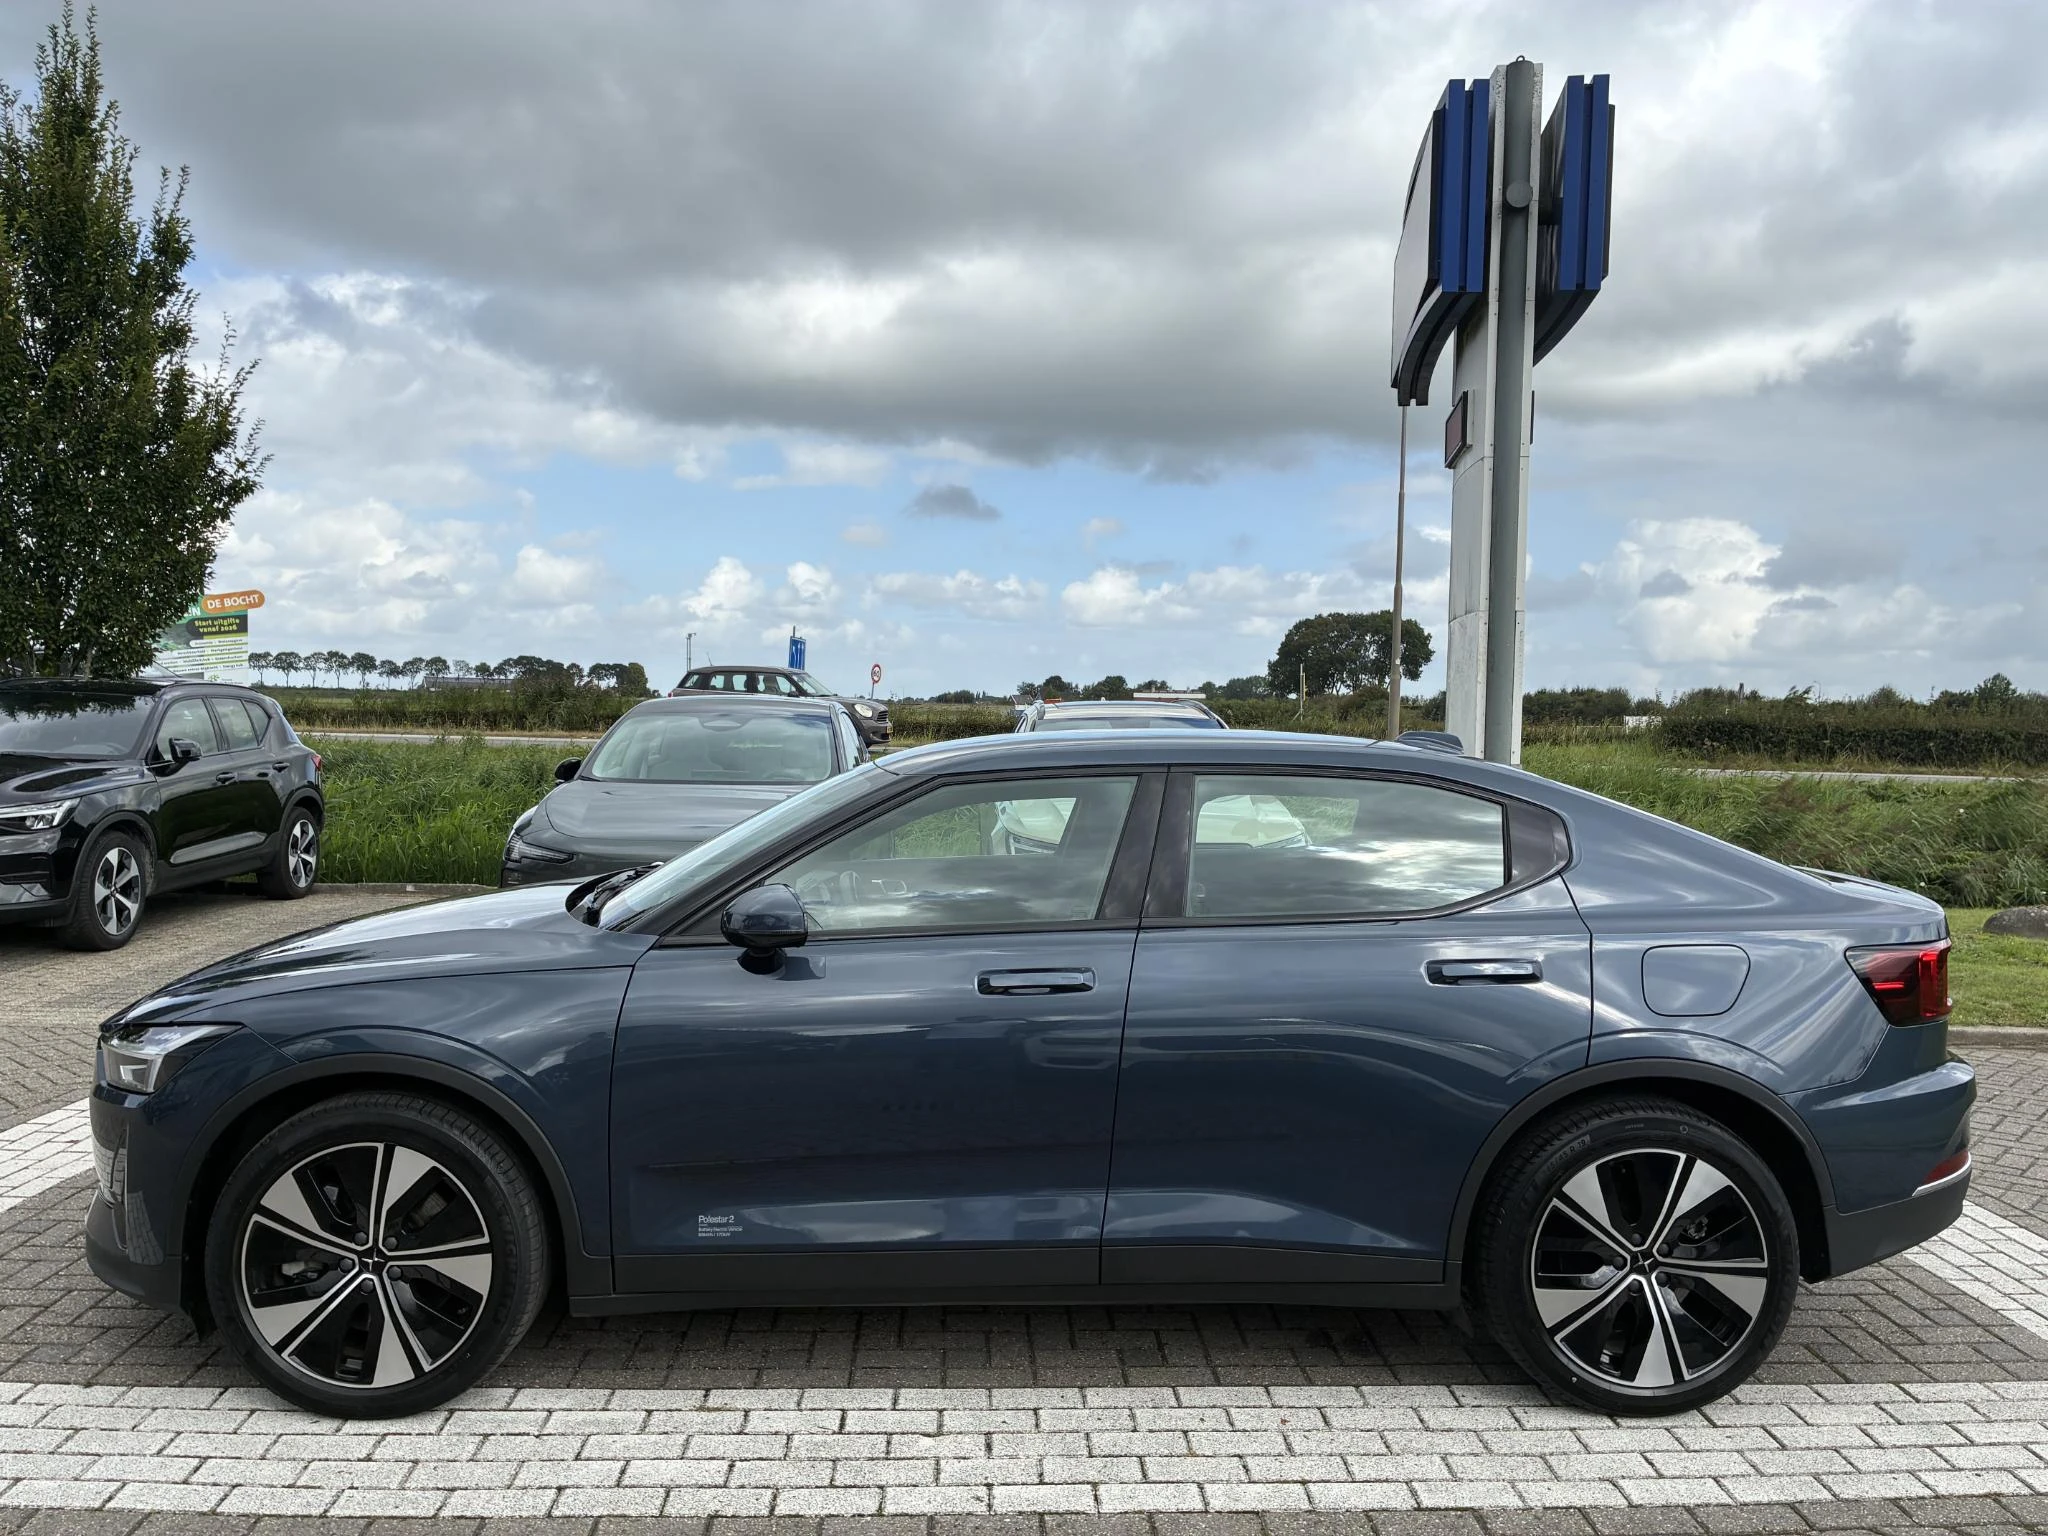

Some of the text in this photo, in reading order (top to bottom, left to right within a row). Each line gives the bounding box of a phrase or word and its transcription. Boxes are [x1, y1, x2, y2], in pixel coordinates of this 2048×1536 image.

[207, 594, 259, 609] DE BOCHT
[194, 619, 212, 627] Start
[698, 1215, 735, 1223] Polestar 2
